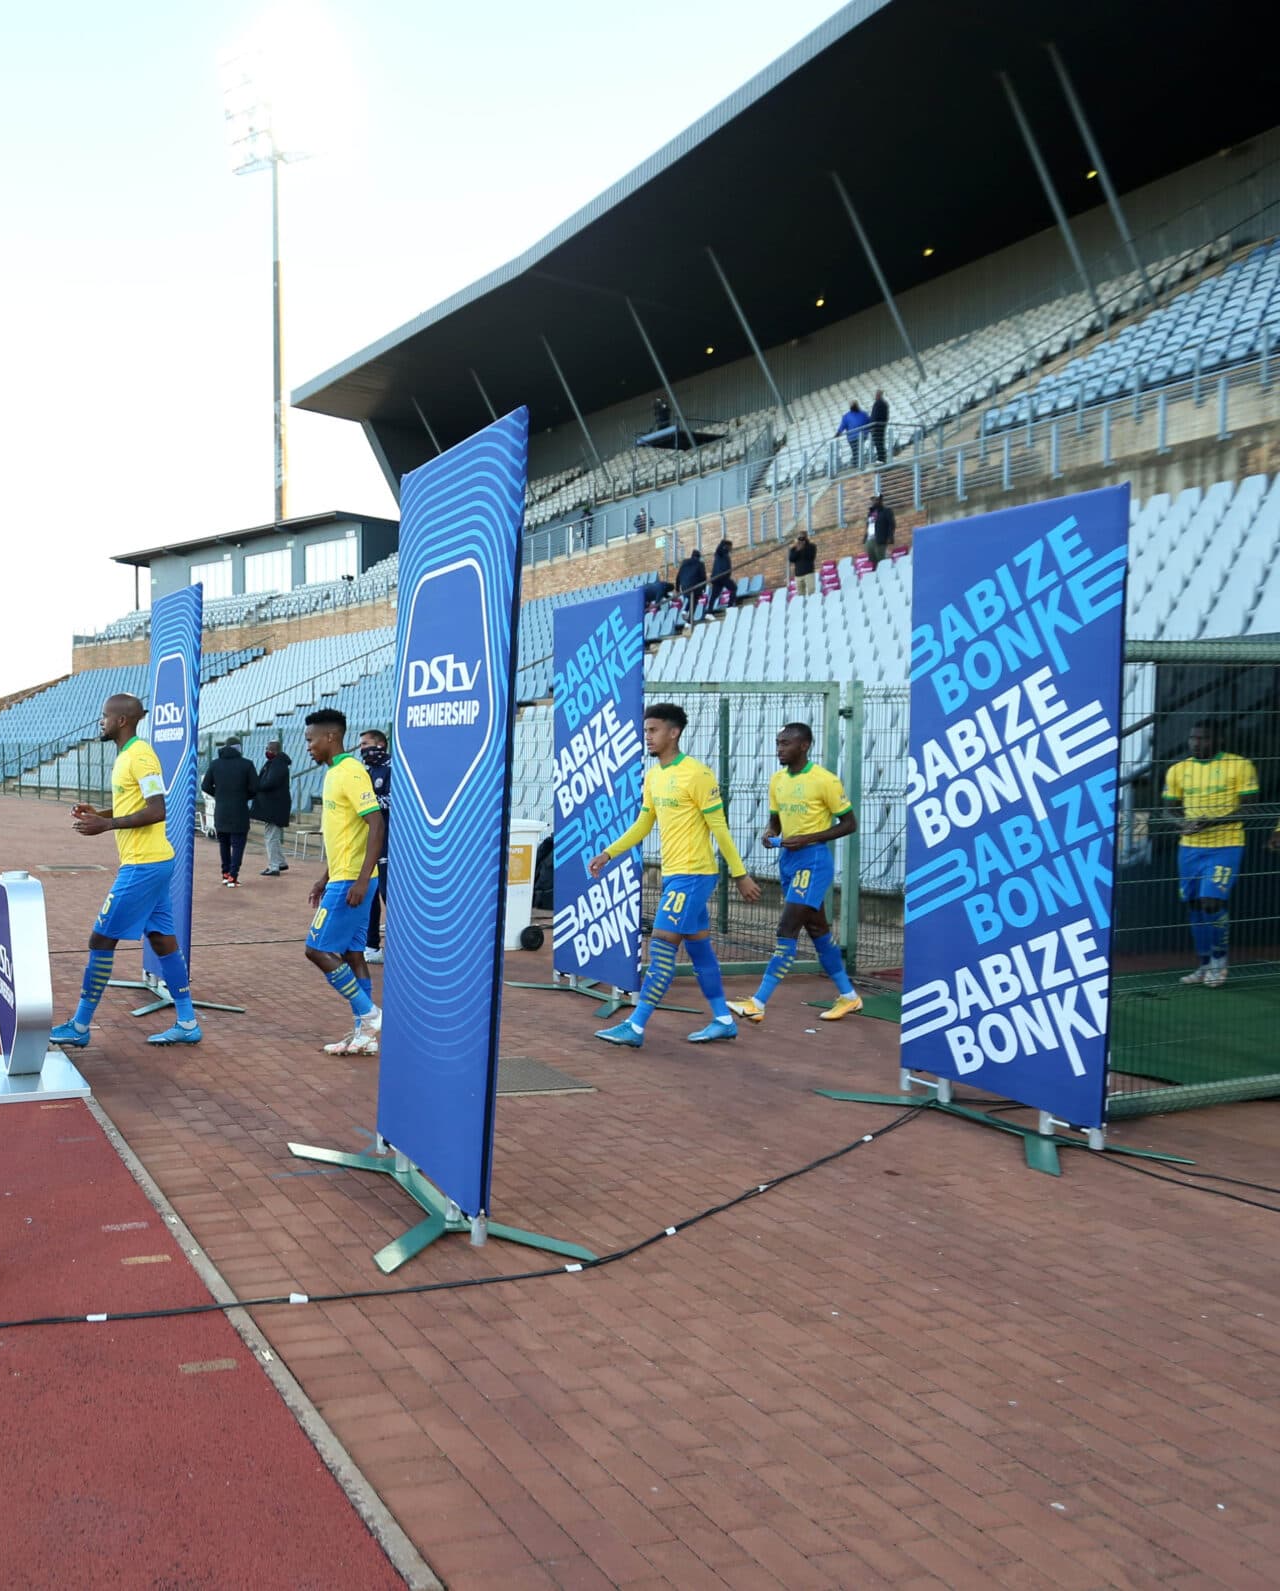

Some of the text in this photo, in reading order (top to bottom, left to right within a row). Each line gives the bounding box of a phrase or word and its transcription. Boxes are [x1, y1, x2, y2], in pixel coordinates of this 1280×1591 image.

[911, 515, 1094, 683] BABIZE
[930, 544, 1128, 716] BONKE
[554, 605, 628, 711] BABIZE
[563, 622, 643, 732] BONKE
[406, 700, 480, 728] PREMIERSHIP
[557, 719, 642, 818] BONKE
[907, 665, 1068, 805] BABIZE
[913, 700, 1118, 849] BONKE
[553, 857, 641, 950] BABIZE
[663, 890, 687, 914] 28
[963, 834, 1114, 945] BONK
[900, 917, 1109, 1045] BABIZE
